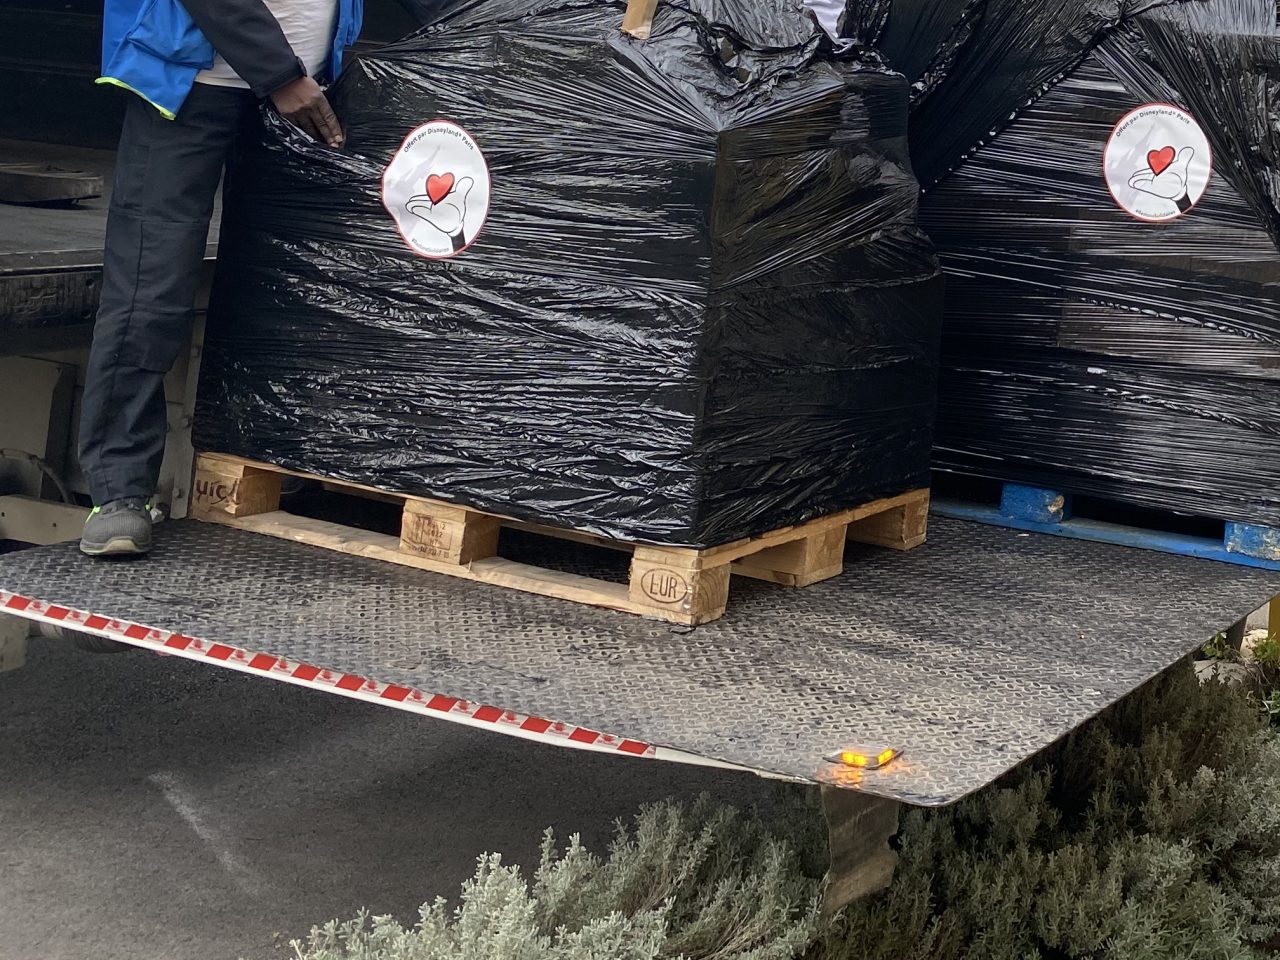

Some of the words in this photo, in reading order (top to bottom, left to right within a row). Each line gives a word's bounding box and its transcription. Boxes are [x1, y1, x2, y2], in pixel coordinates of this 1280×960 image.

[1116, 123, 1130, 137] Offert
[1130, 116, 1139, 125] par
[1176, 113, 1190, 124] Paris
[404, 137, 418, 153] Offert
[418, 131, 427, 141] par
[461, 137, 475, 151] Paris
[649, 572, 678, 599] EUR
